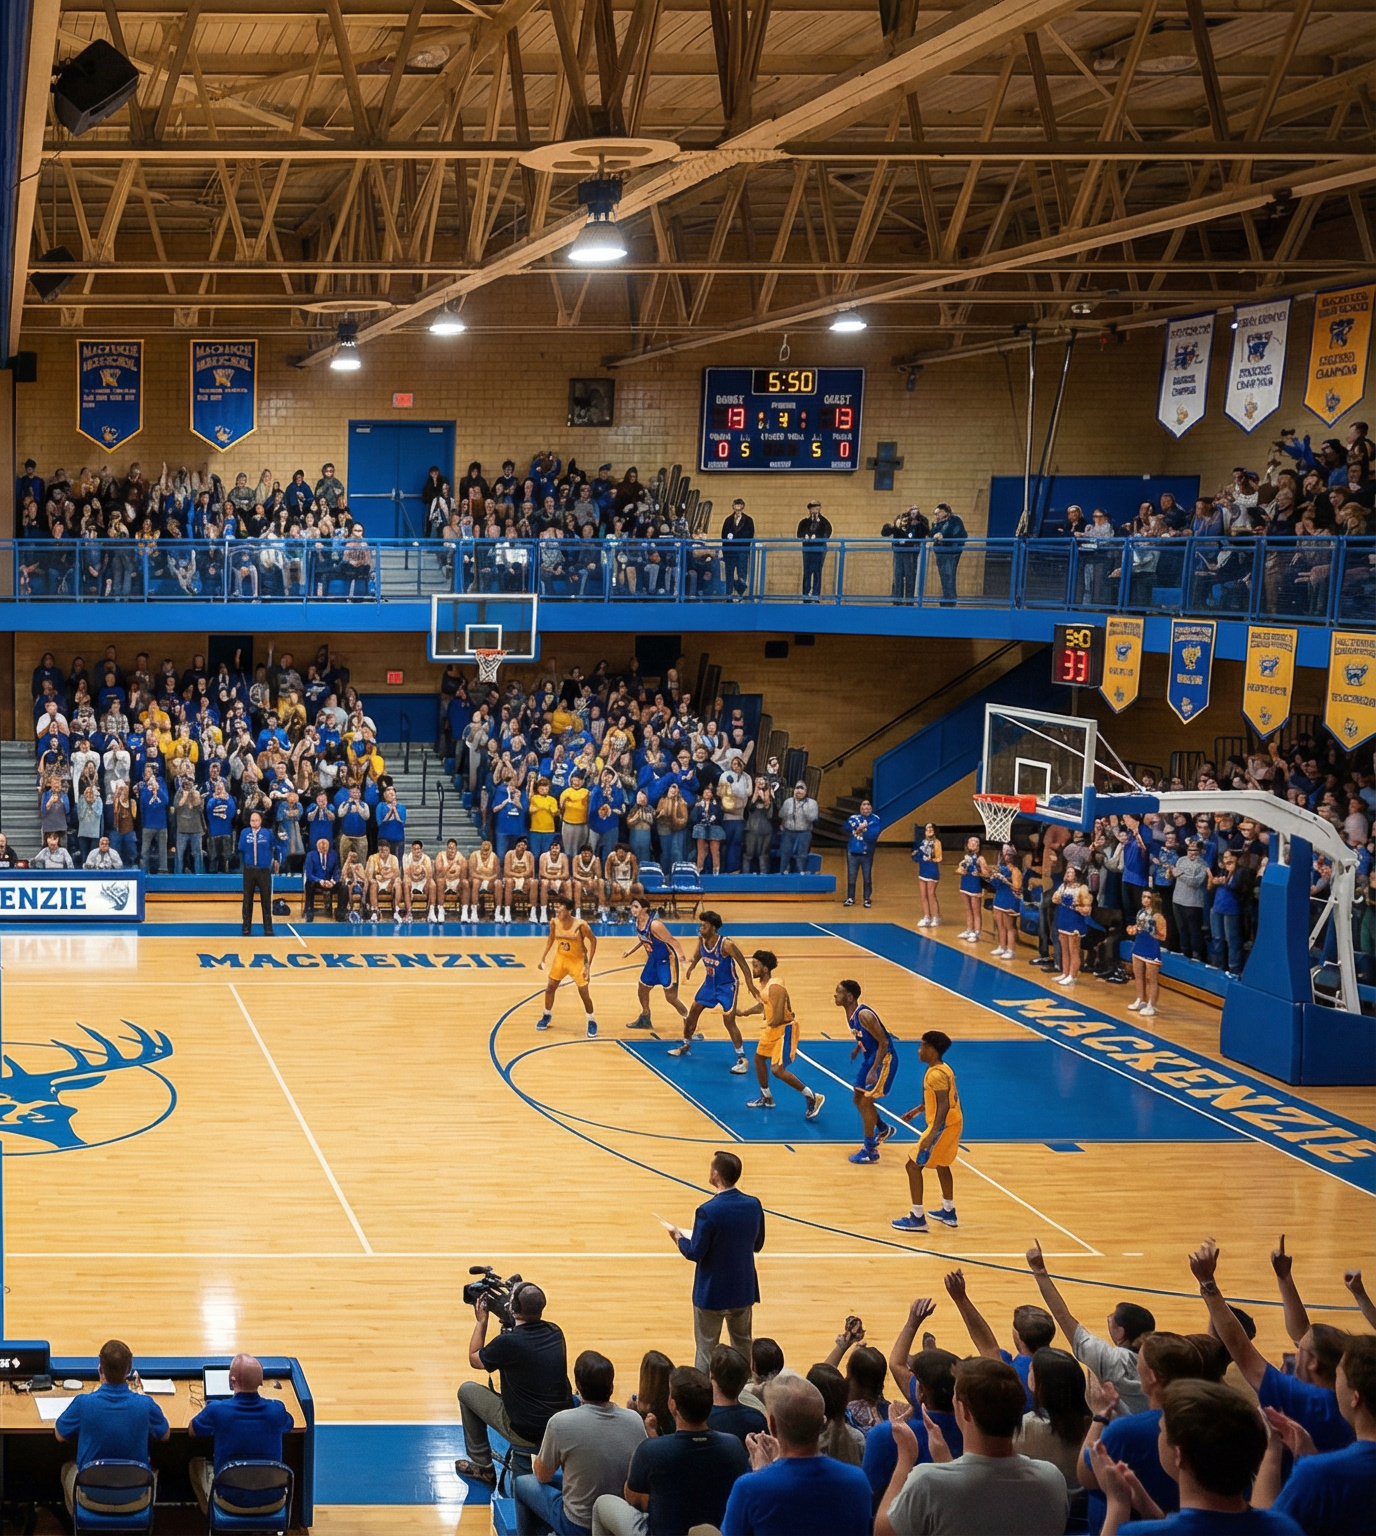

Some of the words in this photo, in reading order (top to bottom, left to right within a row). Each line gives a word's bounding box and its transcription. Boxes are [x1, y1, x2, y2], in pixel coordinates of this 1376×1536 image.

[768, 371, 813, 392] 5:50
[728, 408, 745, 429] 13
[835, 408, 853, 430] 13
[718, 442, 729, 458] 0
[811, 442, 822, 458] 5
[840, 441, 850, 458] 0
[1063, 649, 1088, 682] 33
[196, 953, 527, 970] MACKENZIE
[993, 997, 1376, 1164] MACKENZIE
